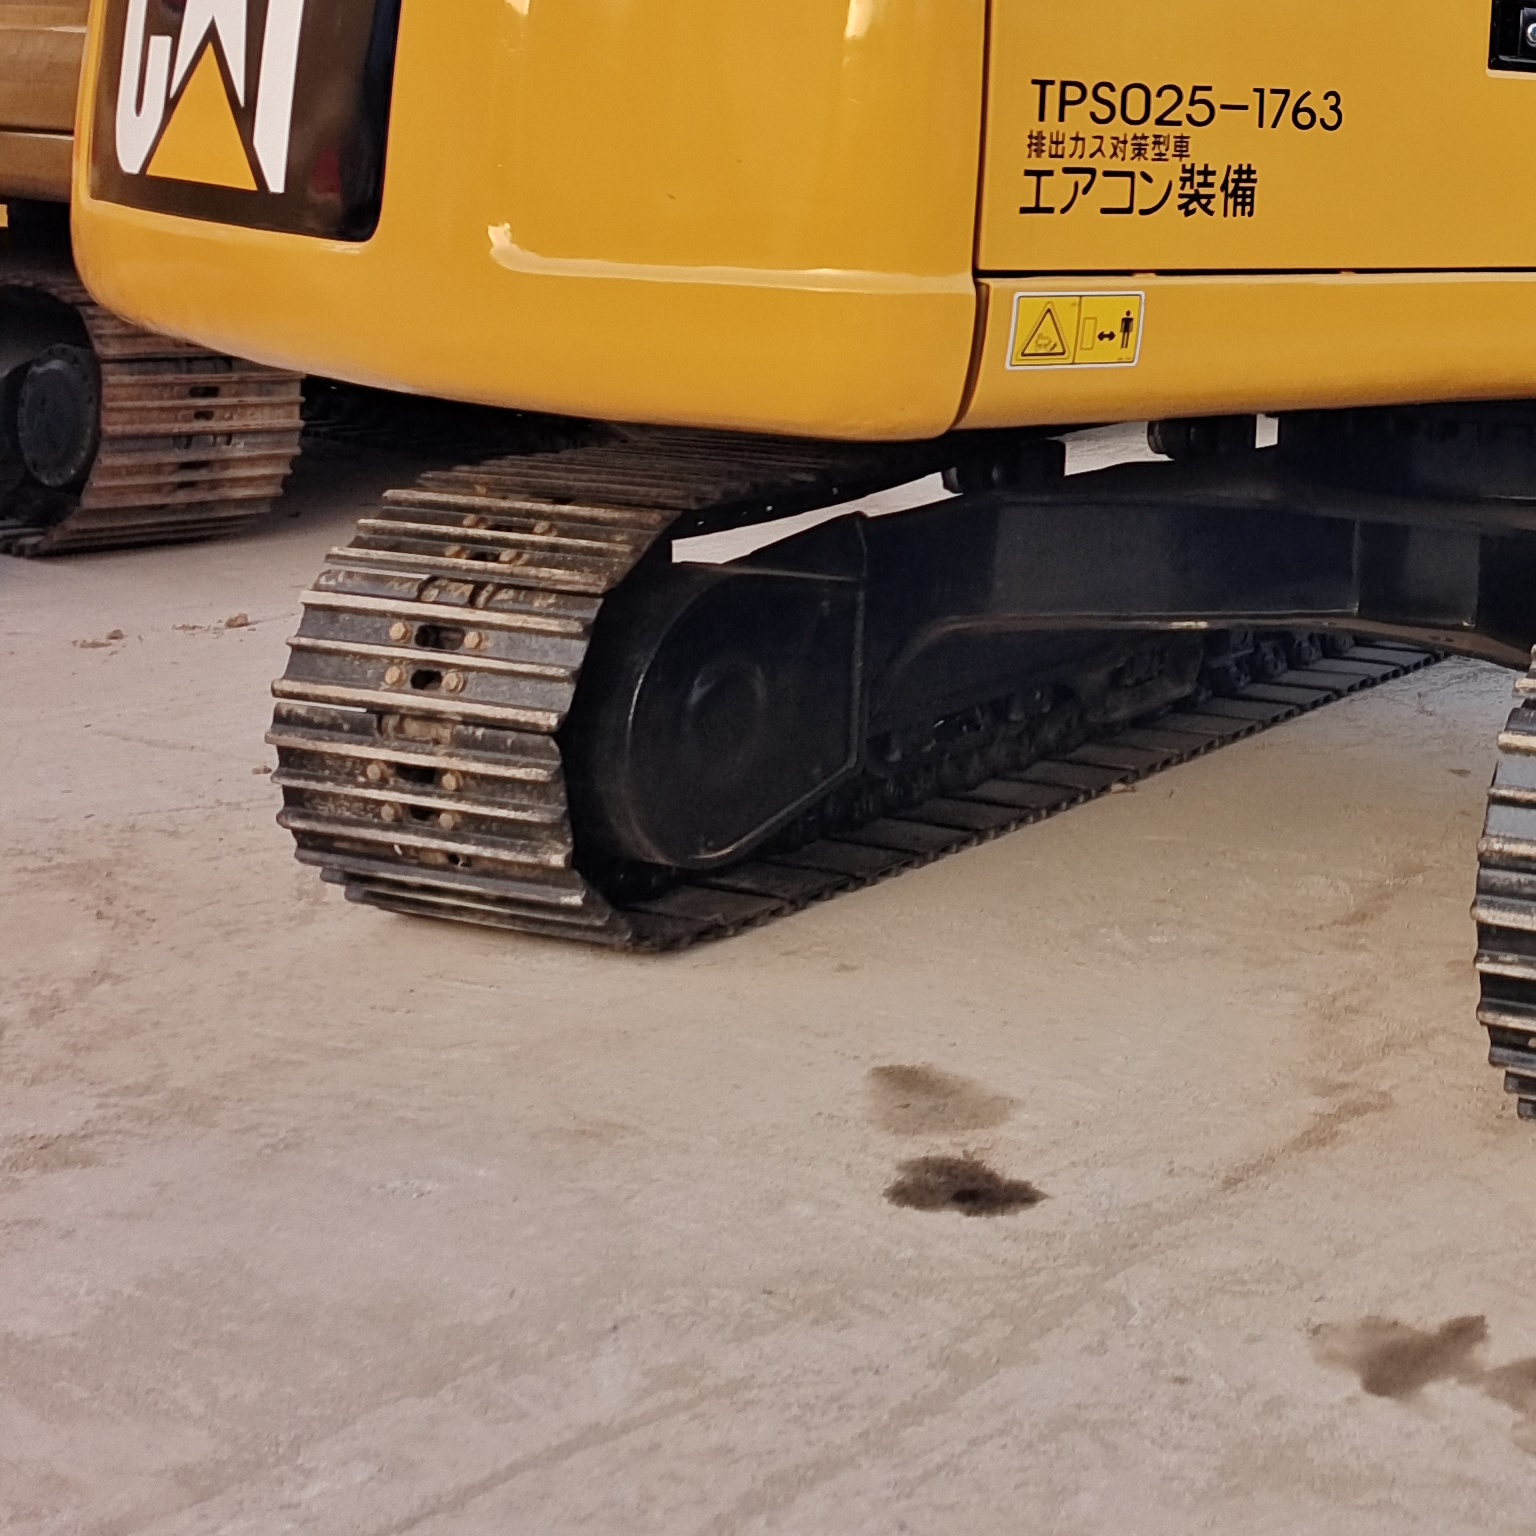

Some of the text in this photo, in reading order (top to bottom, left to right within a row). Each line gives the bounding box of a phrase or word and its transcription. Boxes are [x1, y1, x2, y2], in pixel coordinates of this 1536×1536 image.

[1019, 163, 1258, 218] エアコン装備
